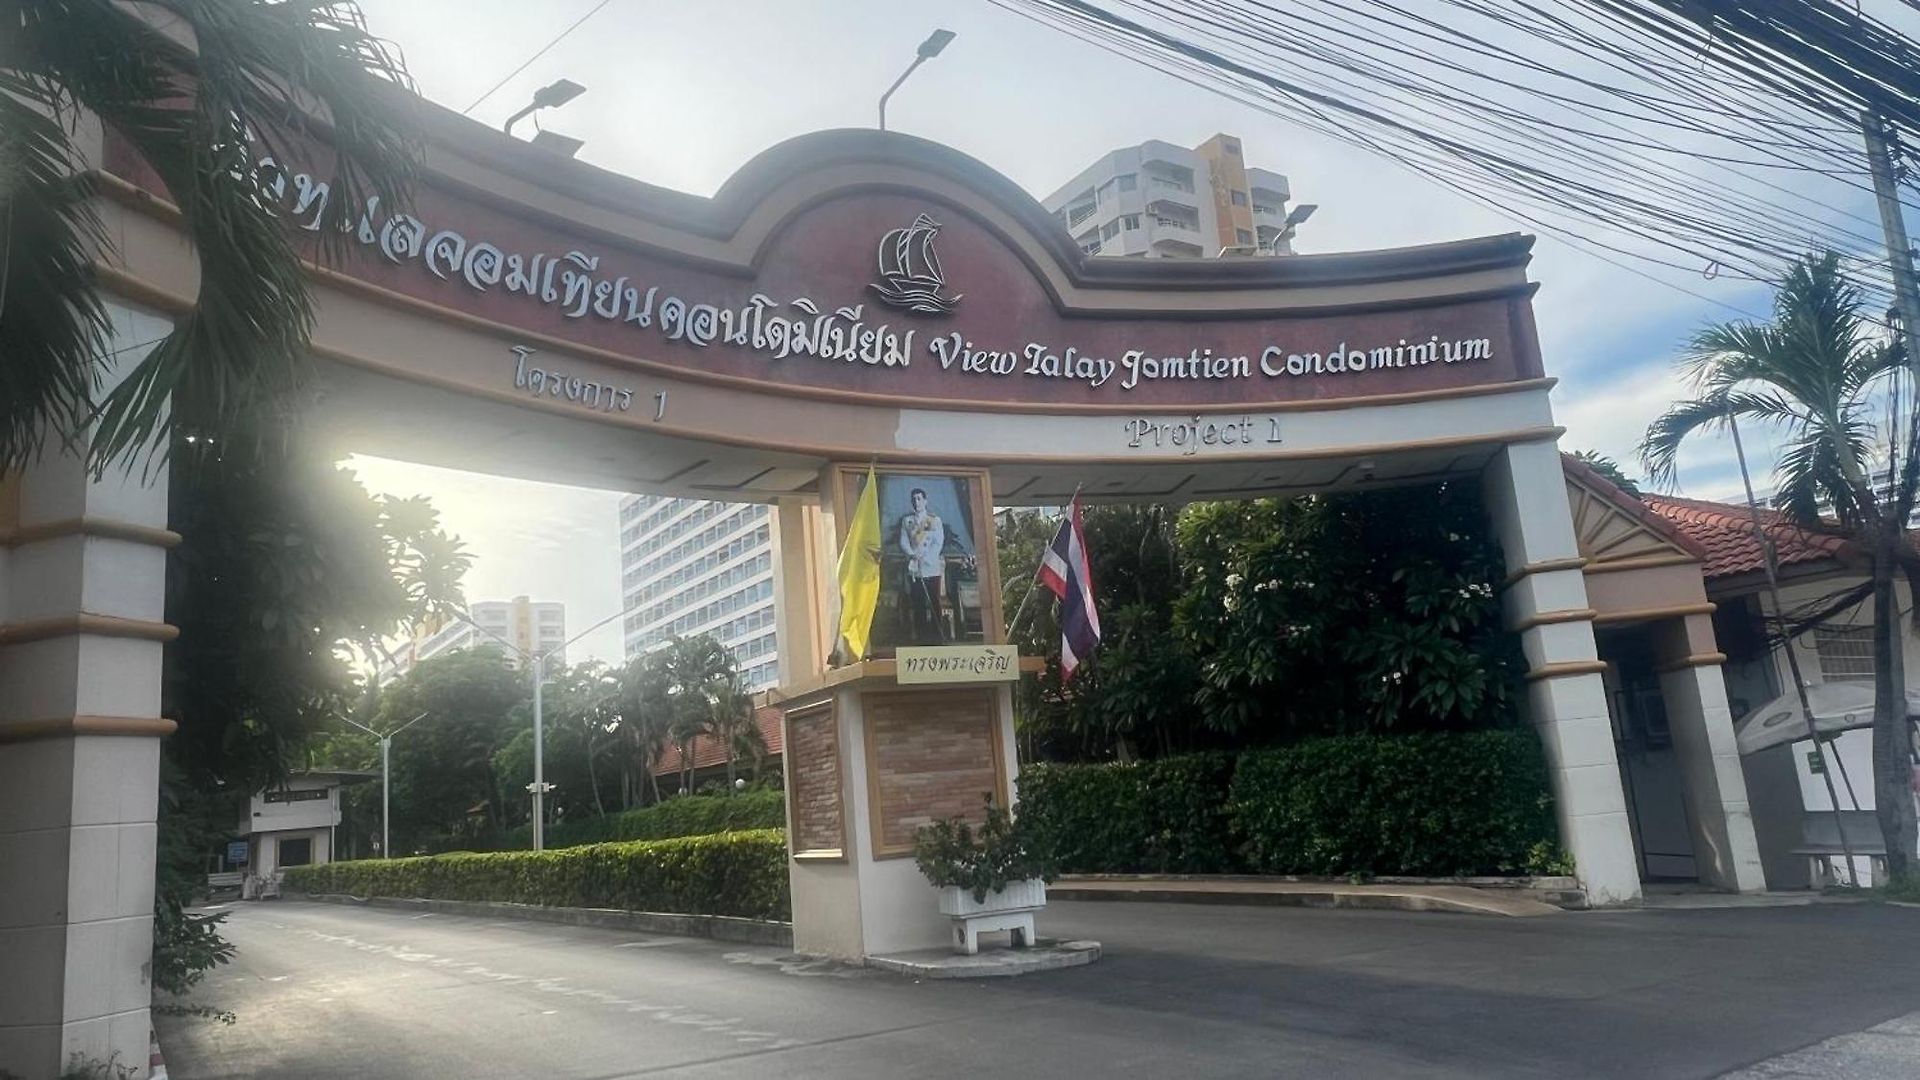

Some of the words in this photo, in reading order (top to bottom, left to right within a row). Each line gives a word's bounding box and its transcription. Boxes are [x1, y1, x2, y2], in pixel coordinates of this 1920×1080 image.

[509, 345, 634, 412] โครงการ
[655, 390, 668, 421] 1
[930, 332, 1017, 375] View
[1023, 343, 1115, 387] Talay
[1121, 349, 1251, 389] Jomtien
[1260, 335, 1493, 377] Condominium
[1125, 415, 1253, 455] Project
[1267, 417, 1283, 443] 1
[905, 649, 1010, 674] ทรงพระเจริญ
